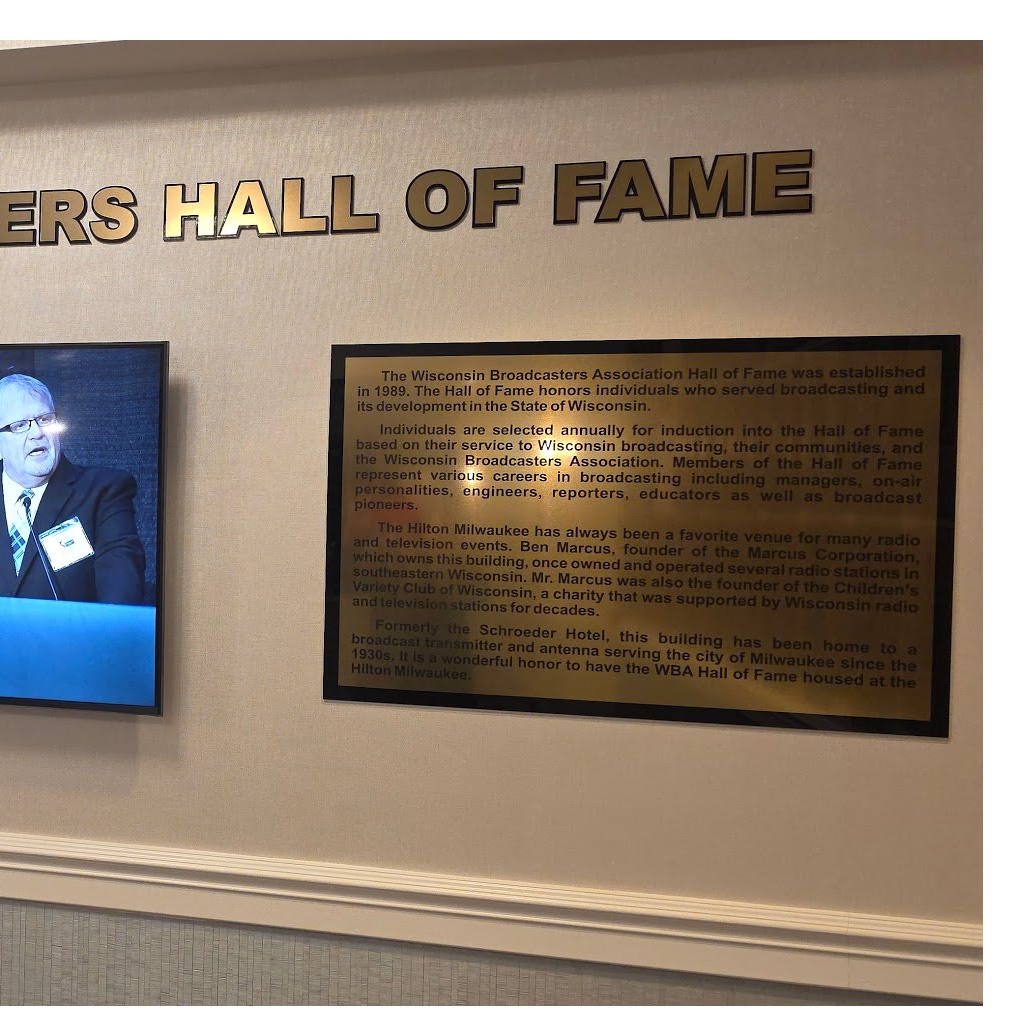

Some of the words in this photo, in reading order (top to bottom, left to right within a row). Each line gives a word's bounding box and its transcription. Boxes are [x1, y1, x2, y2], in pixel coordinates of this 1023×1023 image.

[163, 176, 380, 242] HALL
[405, 166, 525, 231] OF
[554, 149, 814, 225] FAME
[381, 370, 407, 381] The
[411, 370, 485, 380] Wisconsin
[489, 369, 588, 380] Broadcasters
[591, 368, 683, 379] Association
[688, 368, 717, 378] Hall
[722, 367, 739, 378] of
[743, 367, 787, 378] Fame
[791, 369, 824, 378] was
[828, 366, 926, 377] established
[357, 386, 369, 396] in
[374, 386, 410, 396] 1989.
[414, 386, 440, 396] The
[444, 386, 471, 396] Hall
[475, 385, 490, 396] of
[494, 385, 534, 396] Fame
[538, 385, 591, 395] honors
[596, 384, 679, 395] individuals
[683, 384, 717, 395] who
[721, 384, 775, 395] served
[780, 383, 889, 397] broadcasting
[893, 383, 925, 394] and
[357, 401, 373, 411] its
[375, 401, 467, 413] development
[469, 401, 482, 411] in
[484, 401, 507, 411] the
[510, 401, 547, 411] State
[550, 401, 565, 411] of
[567, 400, 651, 411] Wisconsin.
[356, 454, 376, 464] the
[384, 454, 456, 465] Wisconsin
[465, 455, 561, 466] Broadcasters
[569, 456, 663, 467] Association.
[673, 457, 744, 468] Members
[753, 458, 768, 468] of
[777, 458, 802, 469] the
[811, 458, 842, 469] Hall
[851, 458, 867, 469] of
[877, 459, 922, 470] Fame
[379, 522, 403, 533] The
[407, 523, 448, 534] Hilton
[454, 524, 529, 536] Milwaukee
[534, 526, 560, 537] has
[565, 527, 617, 540] always
[623, 528, 660, 539] been
[665, 531, 674, 540] a
[679, 529, 738, 541] favorite
[743, 533, 792, 543] venue
[798, 532, 821, 543] for
[826, 535, 873, 547] many
[877, 534, 920, 546] radio
[351, 663, 390, 675] Hilton
[395, 665, 470, 680] Milwaukee.
